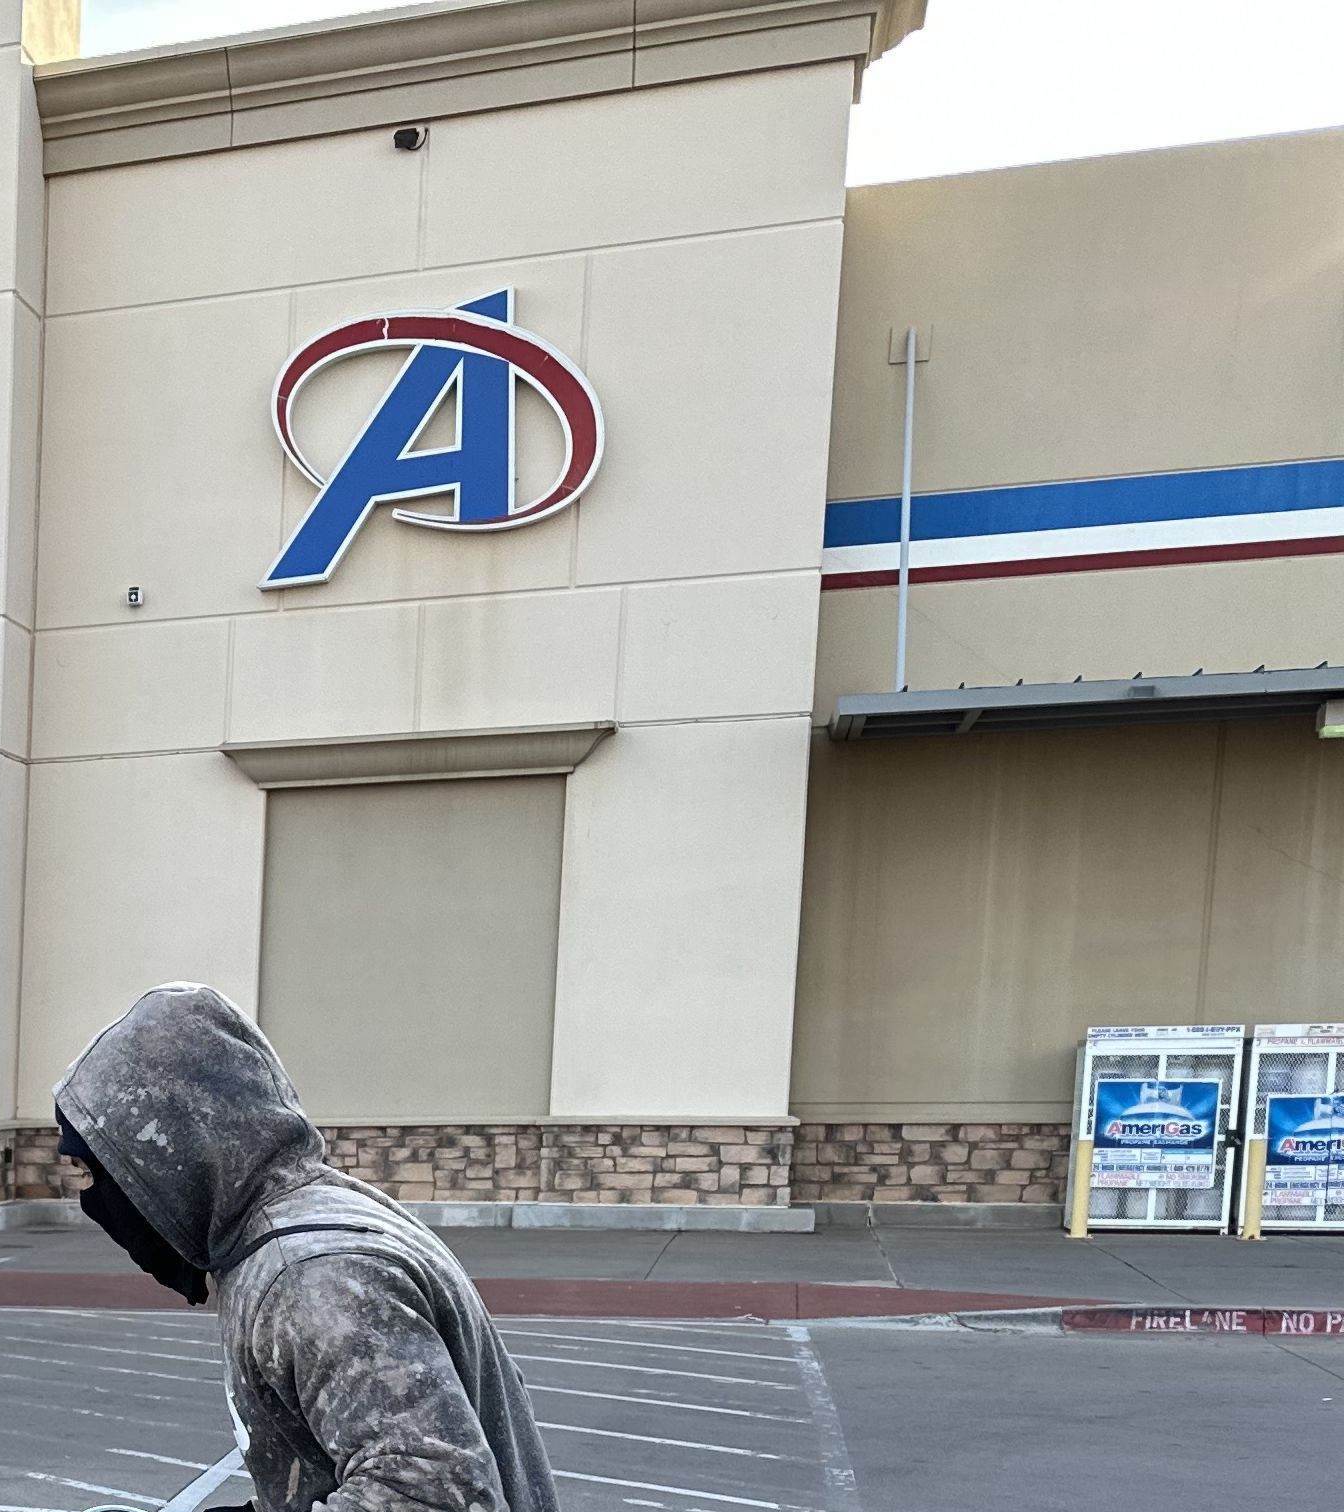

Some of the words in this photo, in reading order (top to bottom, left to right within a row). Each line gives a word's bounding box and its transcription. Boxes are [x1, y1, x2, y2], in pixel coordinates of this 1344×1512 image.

[1107, 1121, 1203, 1136] AmeriGas
[1279, 1138, 1344, 1151] Ameri
[1279, 1311, 1316, 1335] NO
